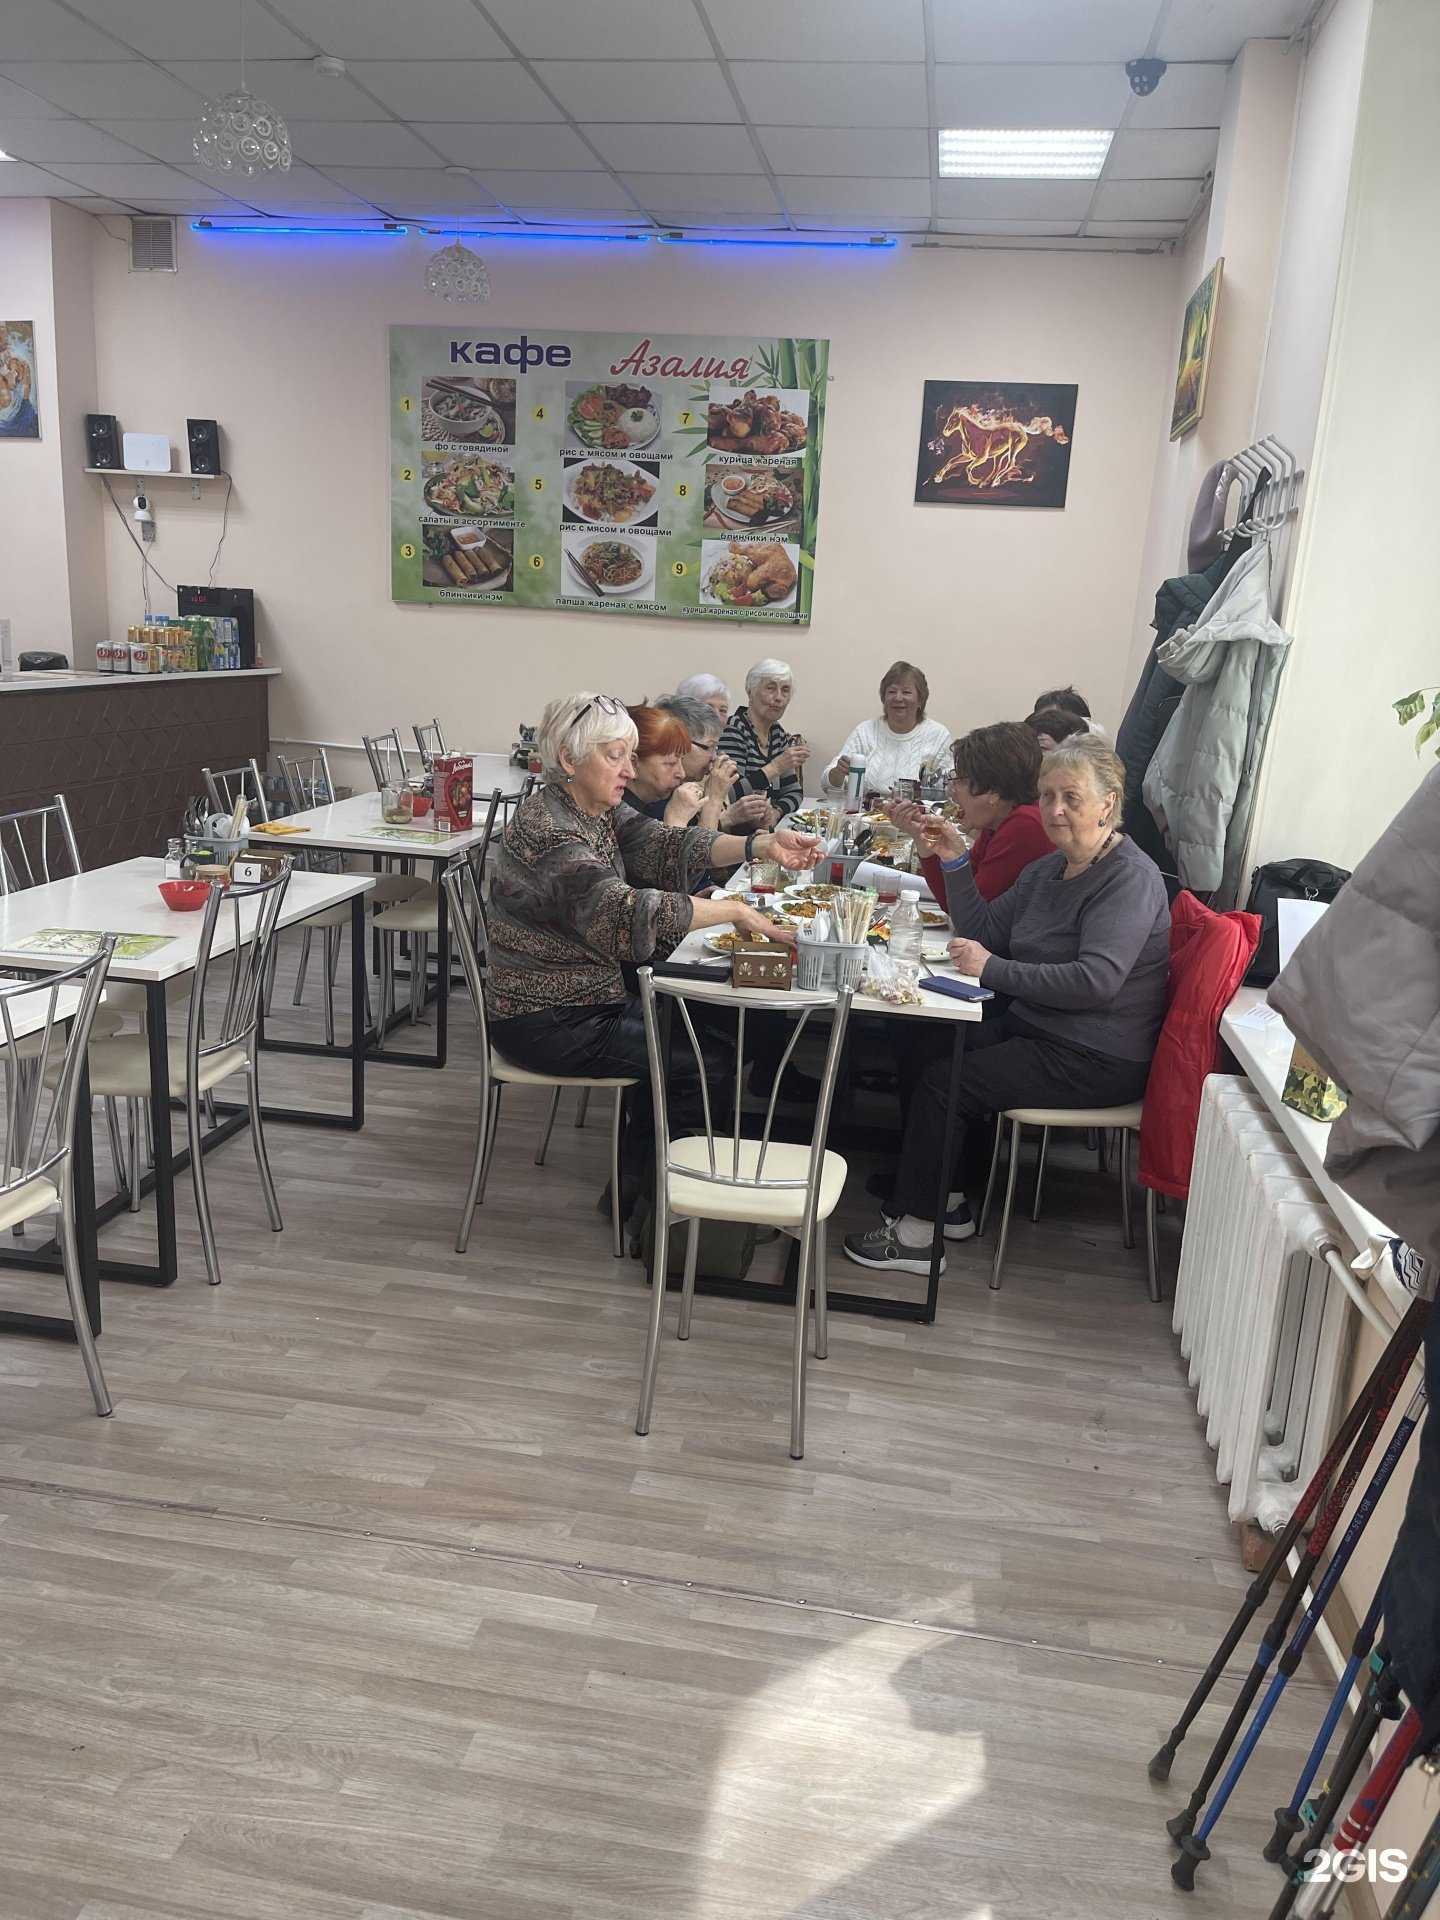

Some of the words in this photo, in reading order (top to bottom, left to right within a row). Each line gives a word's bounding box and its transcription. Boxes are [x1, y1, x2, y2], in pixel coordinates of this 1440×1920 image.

[450, 336, 572, 374] кафе
[610, 339, 751, 379] Азалия
[404, 399, 411, 411] 1
[536, 408, 544, 419] 4
[682, 413, 690, 424] 7
[435, 442, 449, 453] фо
[459, 444, 509, 453] говядиной
[560, 449, 577, 458] рис
[629, 453, 673, 461] овощами
[720, 456, 752, 465] курица
[755, 457, 797, 466] жареная
[404, 470, 411, 480] 2
[535, 479, 542, 490] 5
[680, 485, 687, 496] 8
[418, 515, 451, 525] салаты
[461, 518, 526, 530] ассортименте
[560, 524, 577, 533] рис
[587, 526, 617, 534] мясом
[628, 528, 672, 537] овощами
[405, 546, 412, 557] 3
[533, 557, 541, 567] 6
[676, 563, 683, 575] 9
[439, 589, 483, 600] блинчики
[485, 592, 503, 601] нэм
[555, 598, 585, 607] лапша
[587, 600, 626, 609] жареная
[637, 604, 667, 612] мясом
[244, 866, 252, 877] 6
